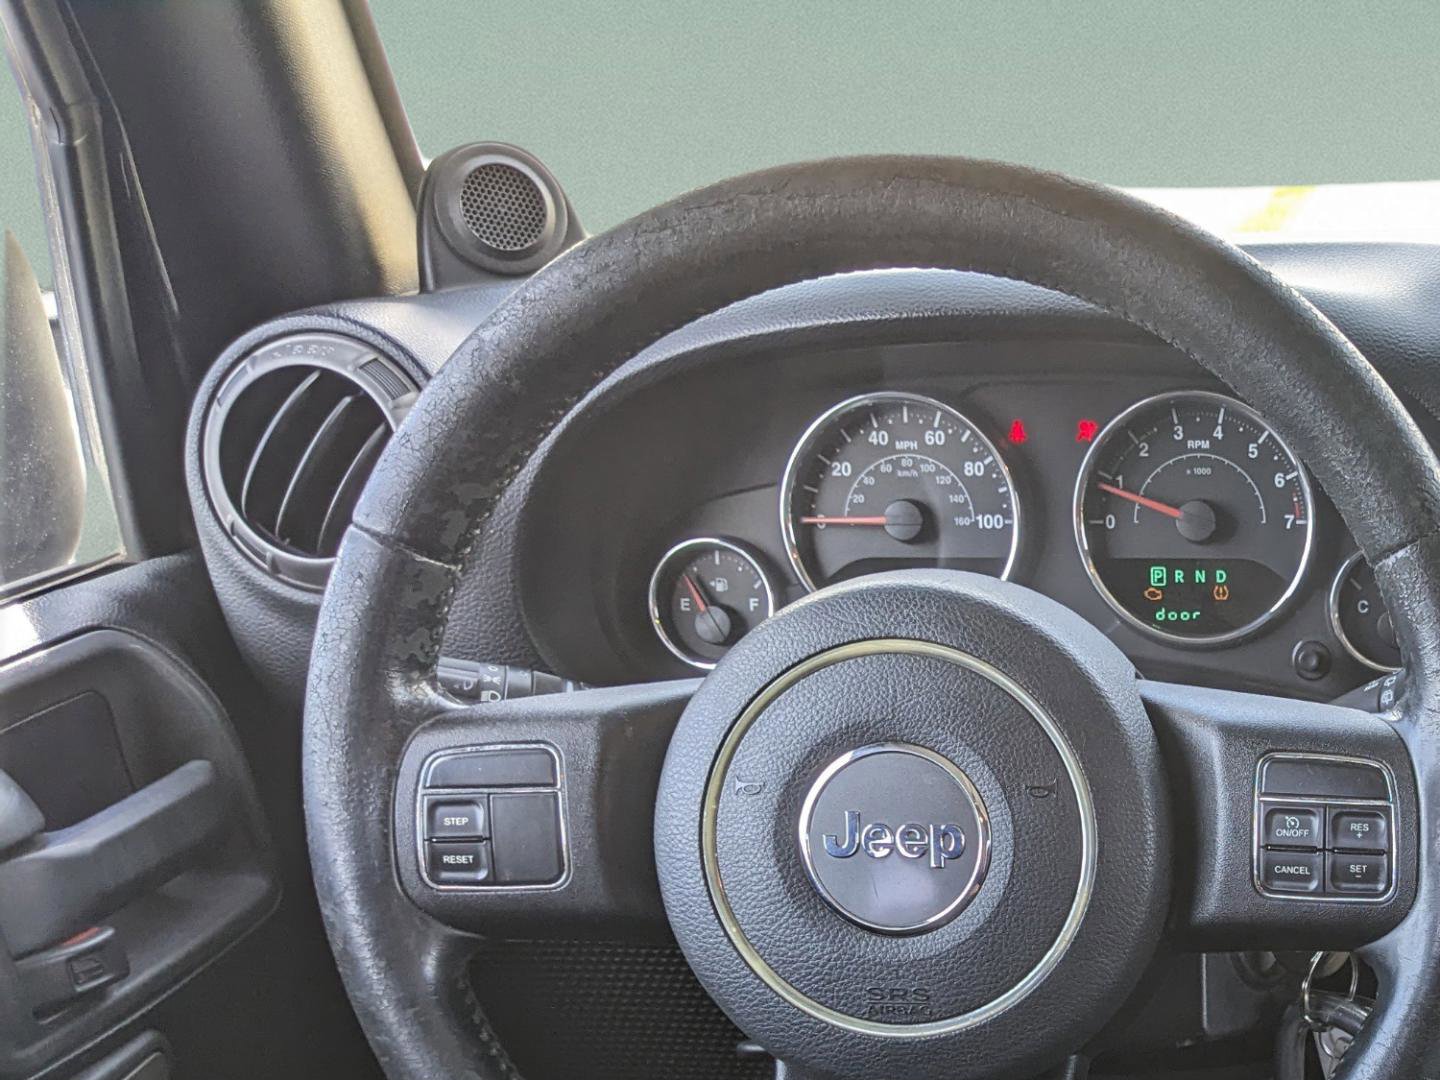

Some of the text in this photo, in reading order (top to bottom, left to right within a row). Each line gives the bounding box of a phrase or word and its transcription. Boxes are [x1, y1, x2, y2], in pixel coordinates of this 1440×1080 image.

[868, 430, 888, 446] 40
[924, 430, 945, 446] 60
[1173, 426, 1184, 440] 3
[1213, 426, 1224, 440] 4
[895, 440, 918, 450] MPH
[1139, 443, 1149, 457] 2
[1187, 440, 1210, 449] RPM
[1248, 444, 1258, 459] 5
[880, 464, 892, 473] 60
[901, 458, 913, 467] 80
[920, 464, 936, 473] 100
[831, 462, 852, 477] 20
[897, 469, 919, 478] km/h
[963, 462, 984, 477] 80
[1193, 467, 1212, 476] 1000
[863, 477, 875, 486] 40
[935, 476, 952, 485] 120
[1274, 473, 1285, 488] 6
[853, 495, 864, 504] 20
[949, 495, 965, 504] 140
[954, 517, 970, 526] 160
[976, 514, 1004, 529] 100
[1105, 515, 1116, 529] 0
[1284, 515, 1294, 529] 7
[1175, 570, 1184, 583] R
[1195, 570, 1206, 583] N
[1216, 570, 1227, 583] D
[680, 598, 690, 611] E
[749, 598, 759, 611] F
[1358, 600, 1369, 613] C
[1156, 607, 1201, 621] door
[443, 817, 469, 826] STEP
[1350, 823, 1369, 832] RES
[823, 810, 966, 869] Jeep
[1275, 829, 1309, 838] ON/OFF
[442, 855, 474, 864] RESET
[1274, 865, 1311, 876] CANCEL
[1349, 864, 1368, 874] SET
[866, 987, 930, 1002] SRS
